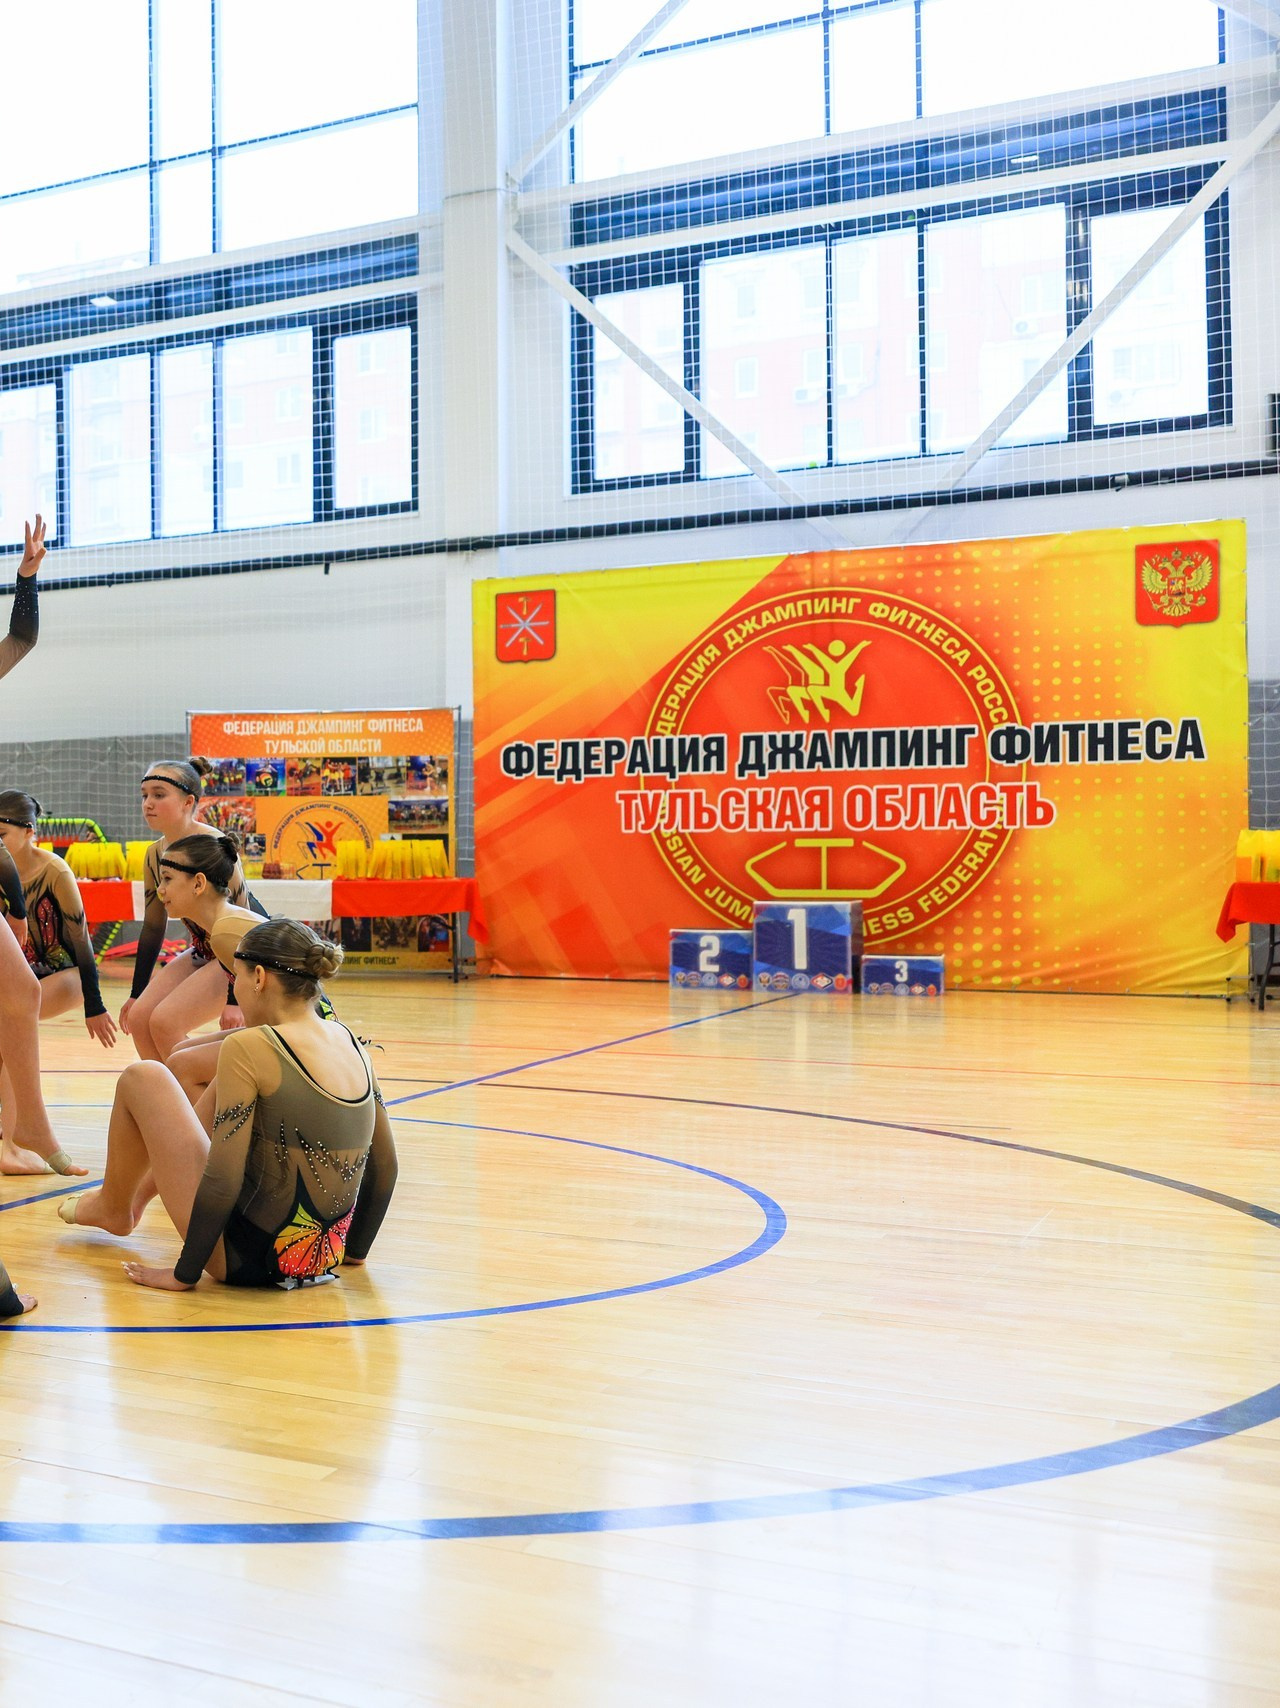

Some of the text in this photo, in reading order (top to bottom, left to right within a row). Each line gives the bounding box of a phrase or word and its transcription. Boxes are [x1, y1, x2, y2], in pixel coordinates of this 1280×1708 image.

[655, 597, 1010, 736] ДЕРАЦИЯ ДЖАМПИНГ ФИТНЕСА РОСС
[223, 718, 424, 736] ФЕДЕРАЦИЯ ДЖАМПИНГ ФИТНЕСА
[265, 737, 382, 754] ТУЛЬСКОЙ ОБЛАСТИ
[503, 719, 1206, 782] ФЕДЕРАЦИЯ ДЖАМПИНГ ФИТНЕСА
[617, 782, 1056, 832] ТУЛЬСКАЯ ОБЛАСТЬ
[699, 935, 720, 972] 2
[787, 908, 807, 970] 1
[894, 960, 908, 982] 3
